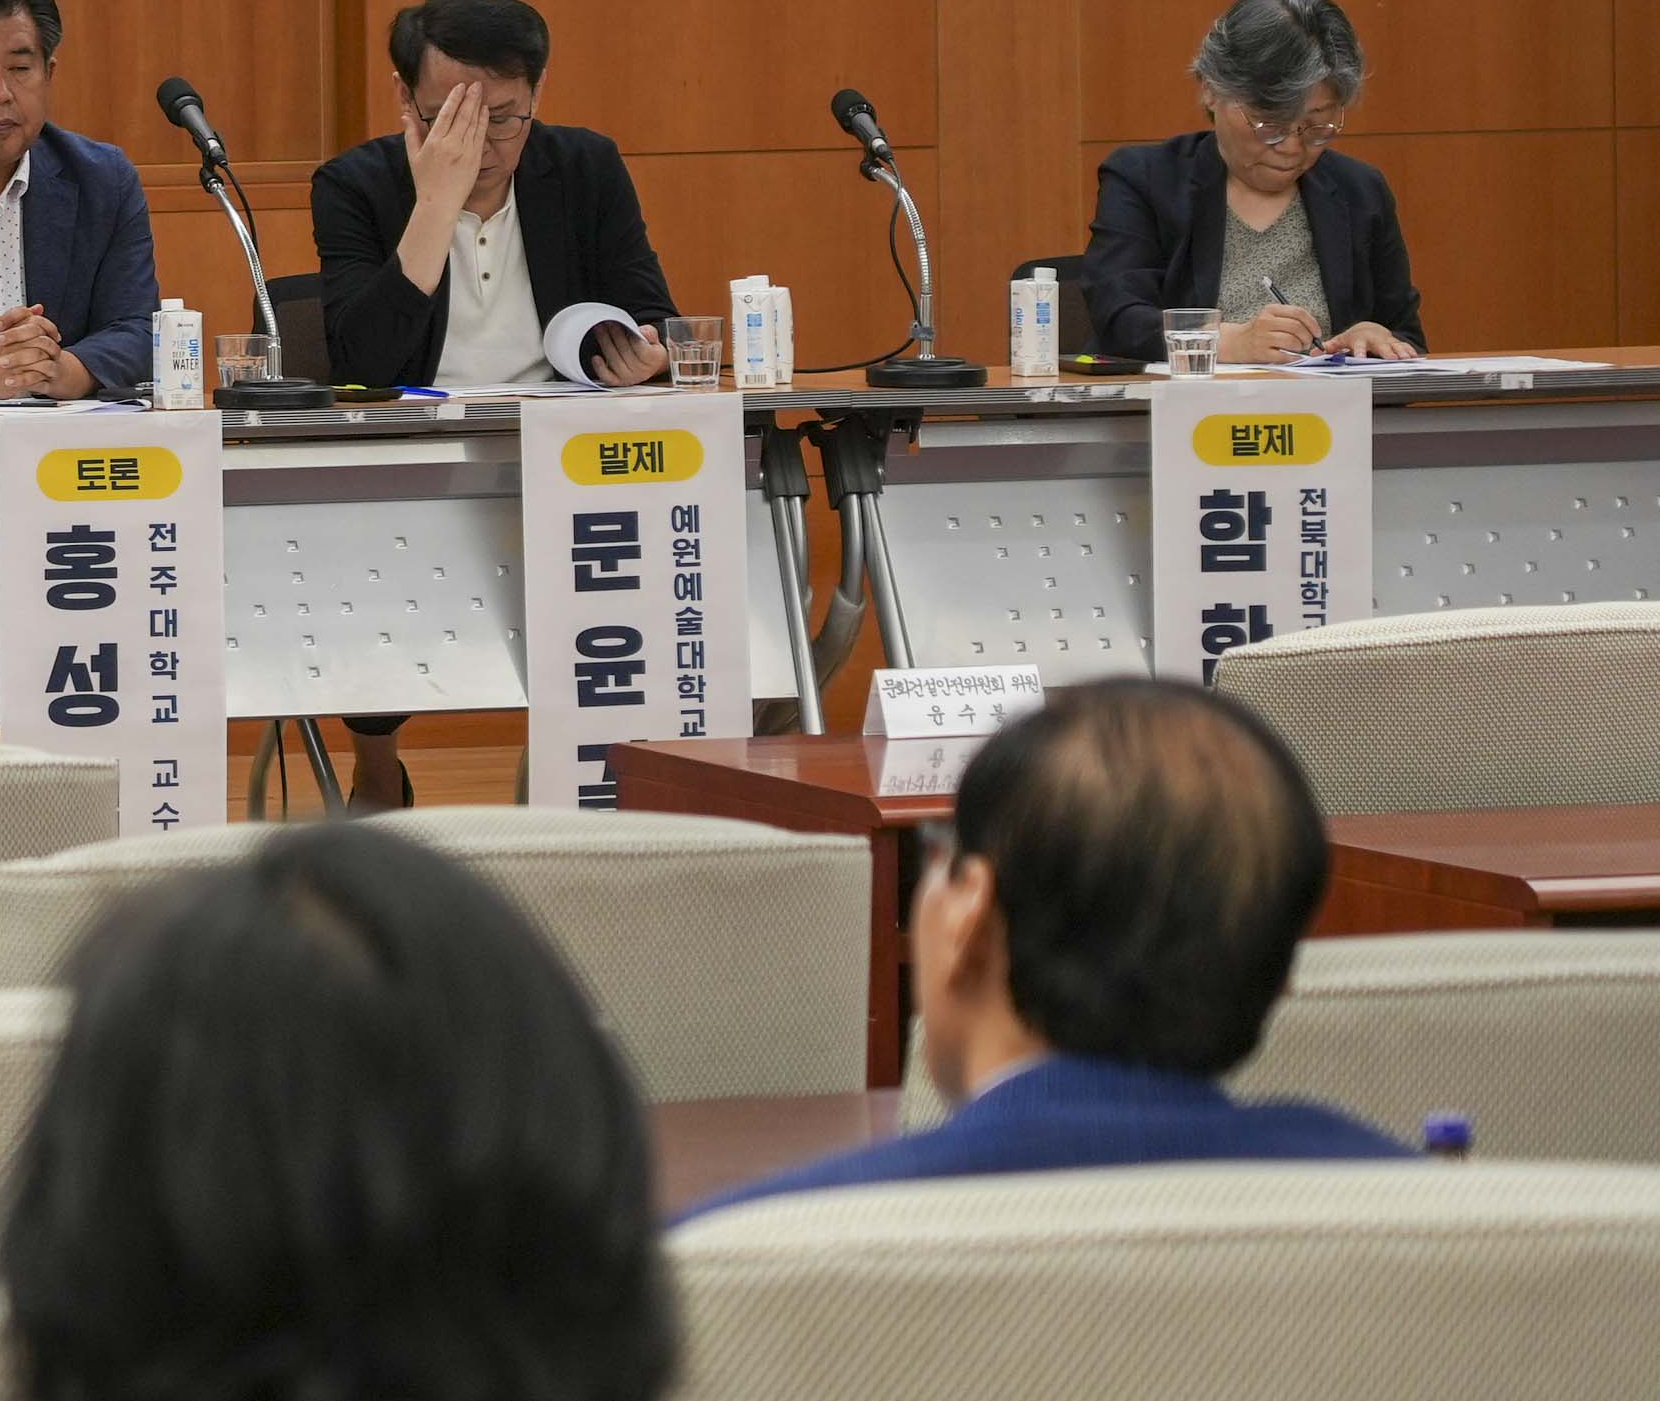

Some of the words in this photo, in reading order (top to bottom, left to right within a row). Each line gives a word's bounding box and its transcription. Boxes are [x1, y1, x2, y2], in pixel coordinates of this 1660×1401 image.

[172, 359, 200, 371] WATER
[1230, 423, 1295, 457] 발제
[76, 457, 141, 492] 토론
[599, 441, 665, 476] 발제
[44, 524, 120, 728] 홍성
[148, 522, 180, 724] 전주대학교
[671, 504, 707, 738] 예원예술대학교
[1011, 673, 1040, 694] 위원
[151, 758, 181, 832] 교수
